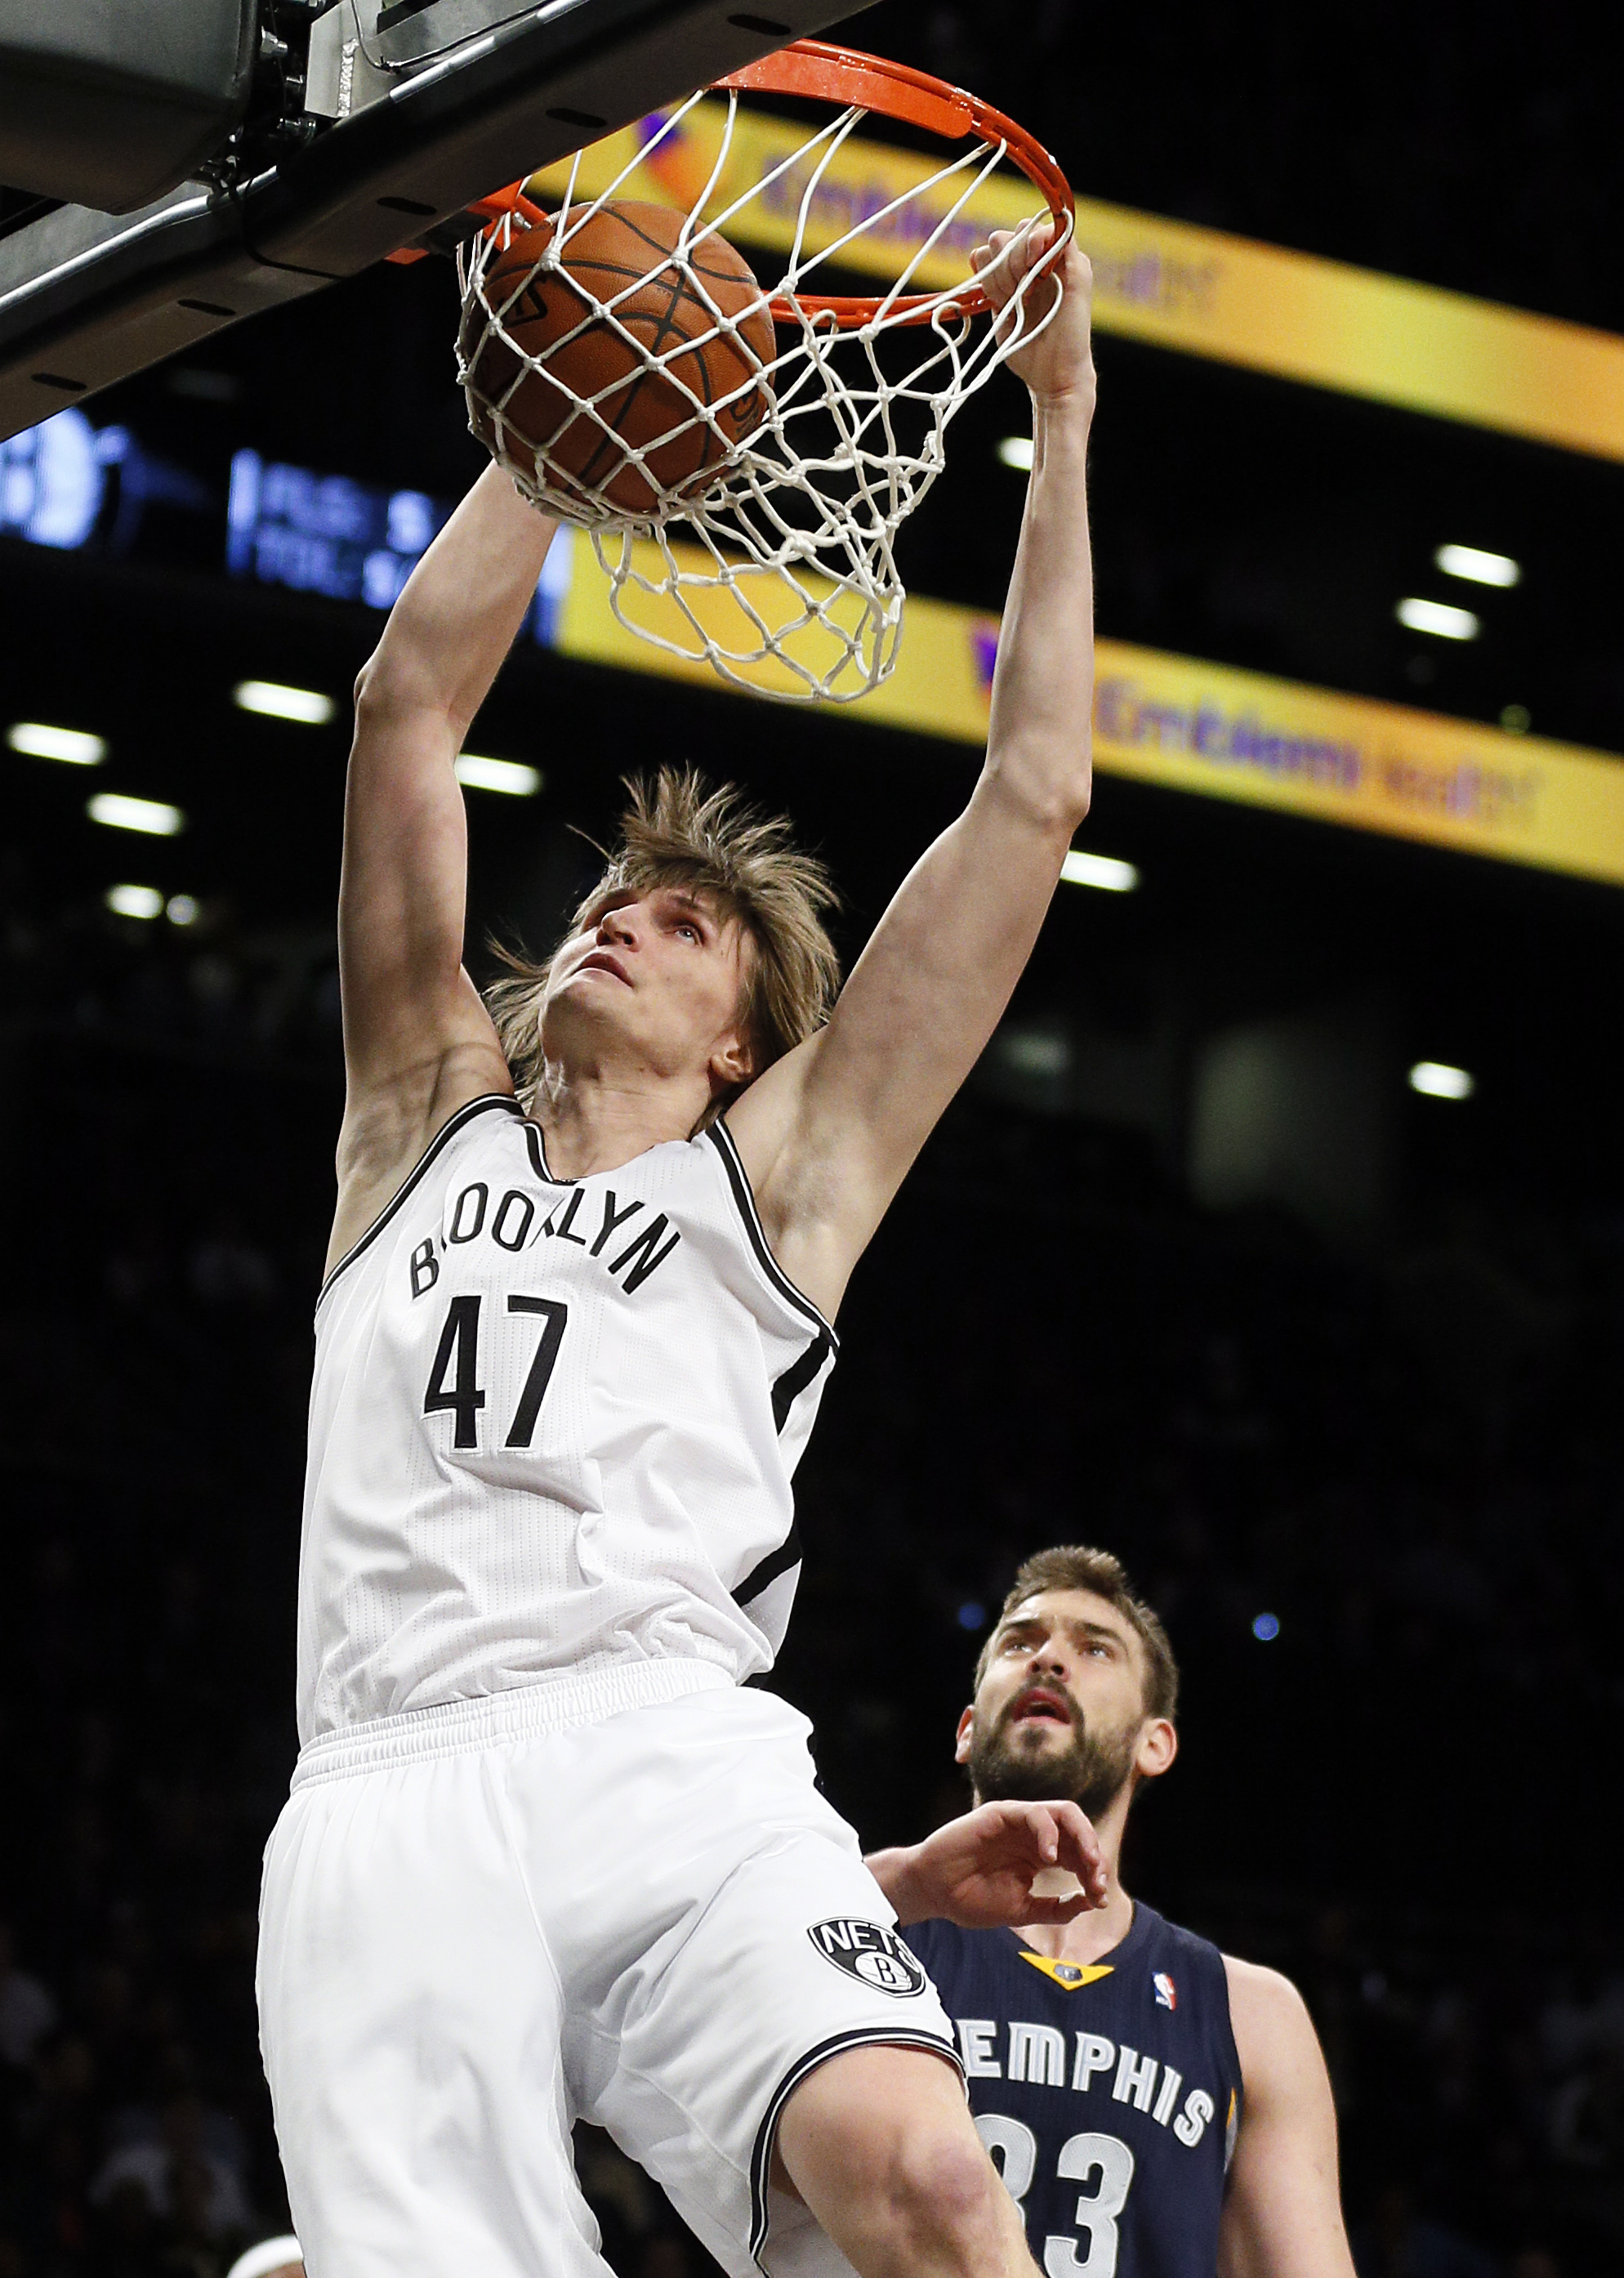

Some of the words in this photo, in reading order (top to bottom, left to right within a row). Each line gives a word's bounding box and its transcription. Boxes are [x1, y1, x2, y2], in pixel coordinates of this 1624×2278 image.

[410, 1181, 681, 1299] BOOLYN
[423, 1294, 568, 1449] 47
[819, 1920, 920, 1974] NETS
[874, 1957, 897, 1984] B
[957, 2019, 1215, 2147] EMPHIS
